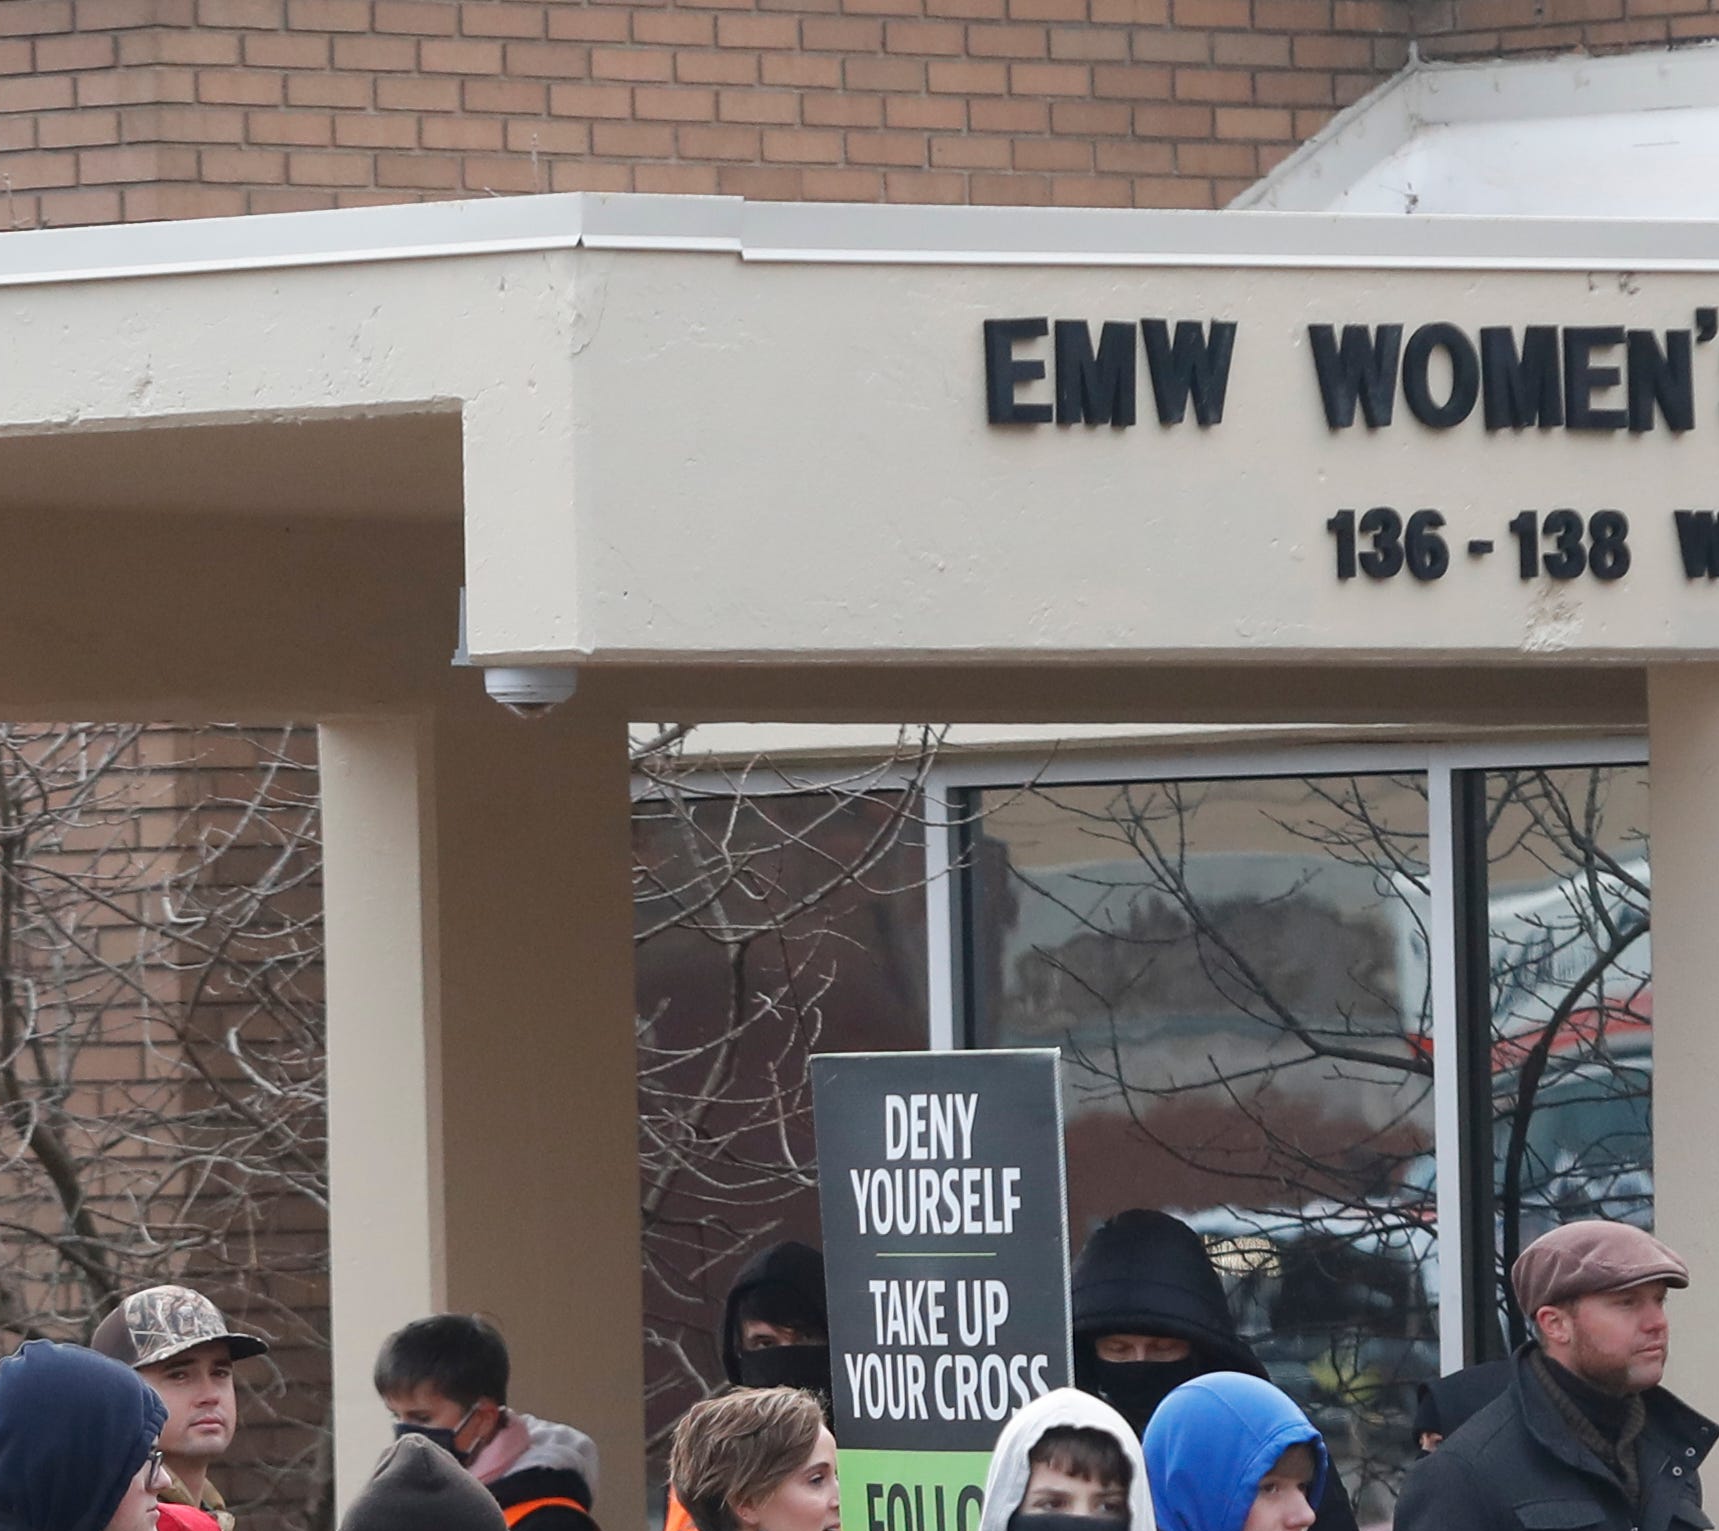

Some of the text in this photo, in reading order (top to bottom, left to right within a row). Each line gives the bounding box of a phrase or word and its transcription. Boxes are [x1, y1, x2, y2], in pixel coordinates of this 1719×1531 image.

[982, 316, 1238, 429] EMW
[885, 1093, 978, 1160] DENY
[850, 1167, 1021, 1235] YOURSELF
[869, 1279, 1009, 1347] TAKE UP
[844, 1353, 1050, 1421] YOUR CROSS
